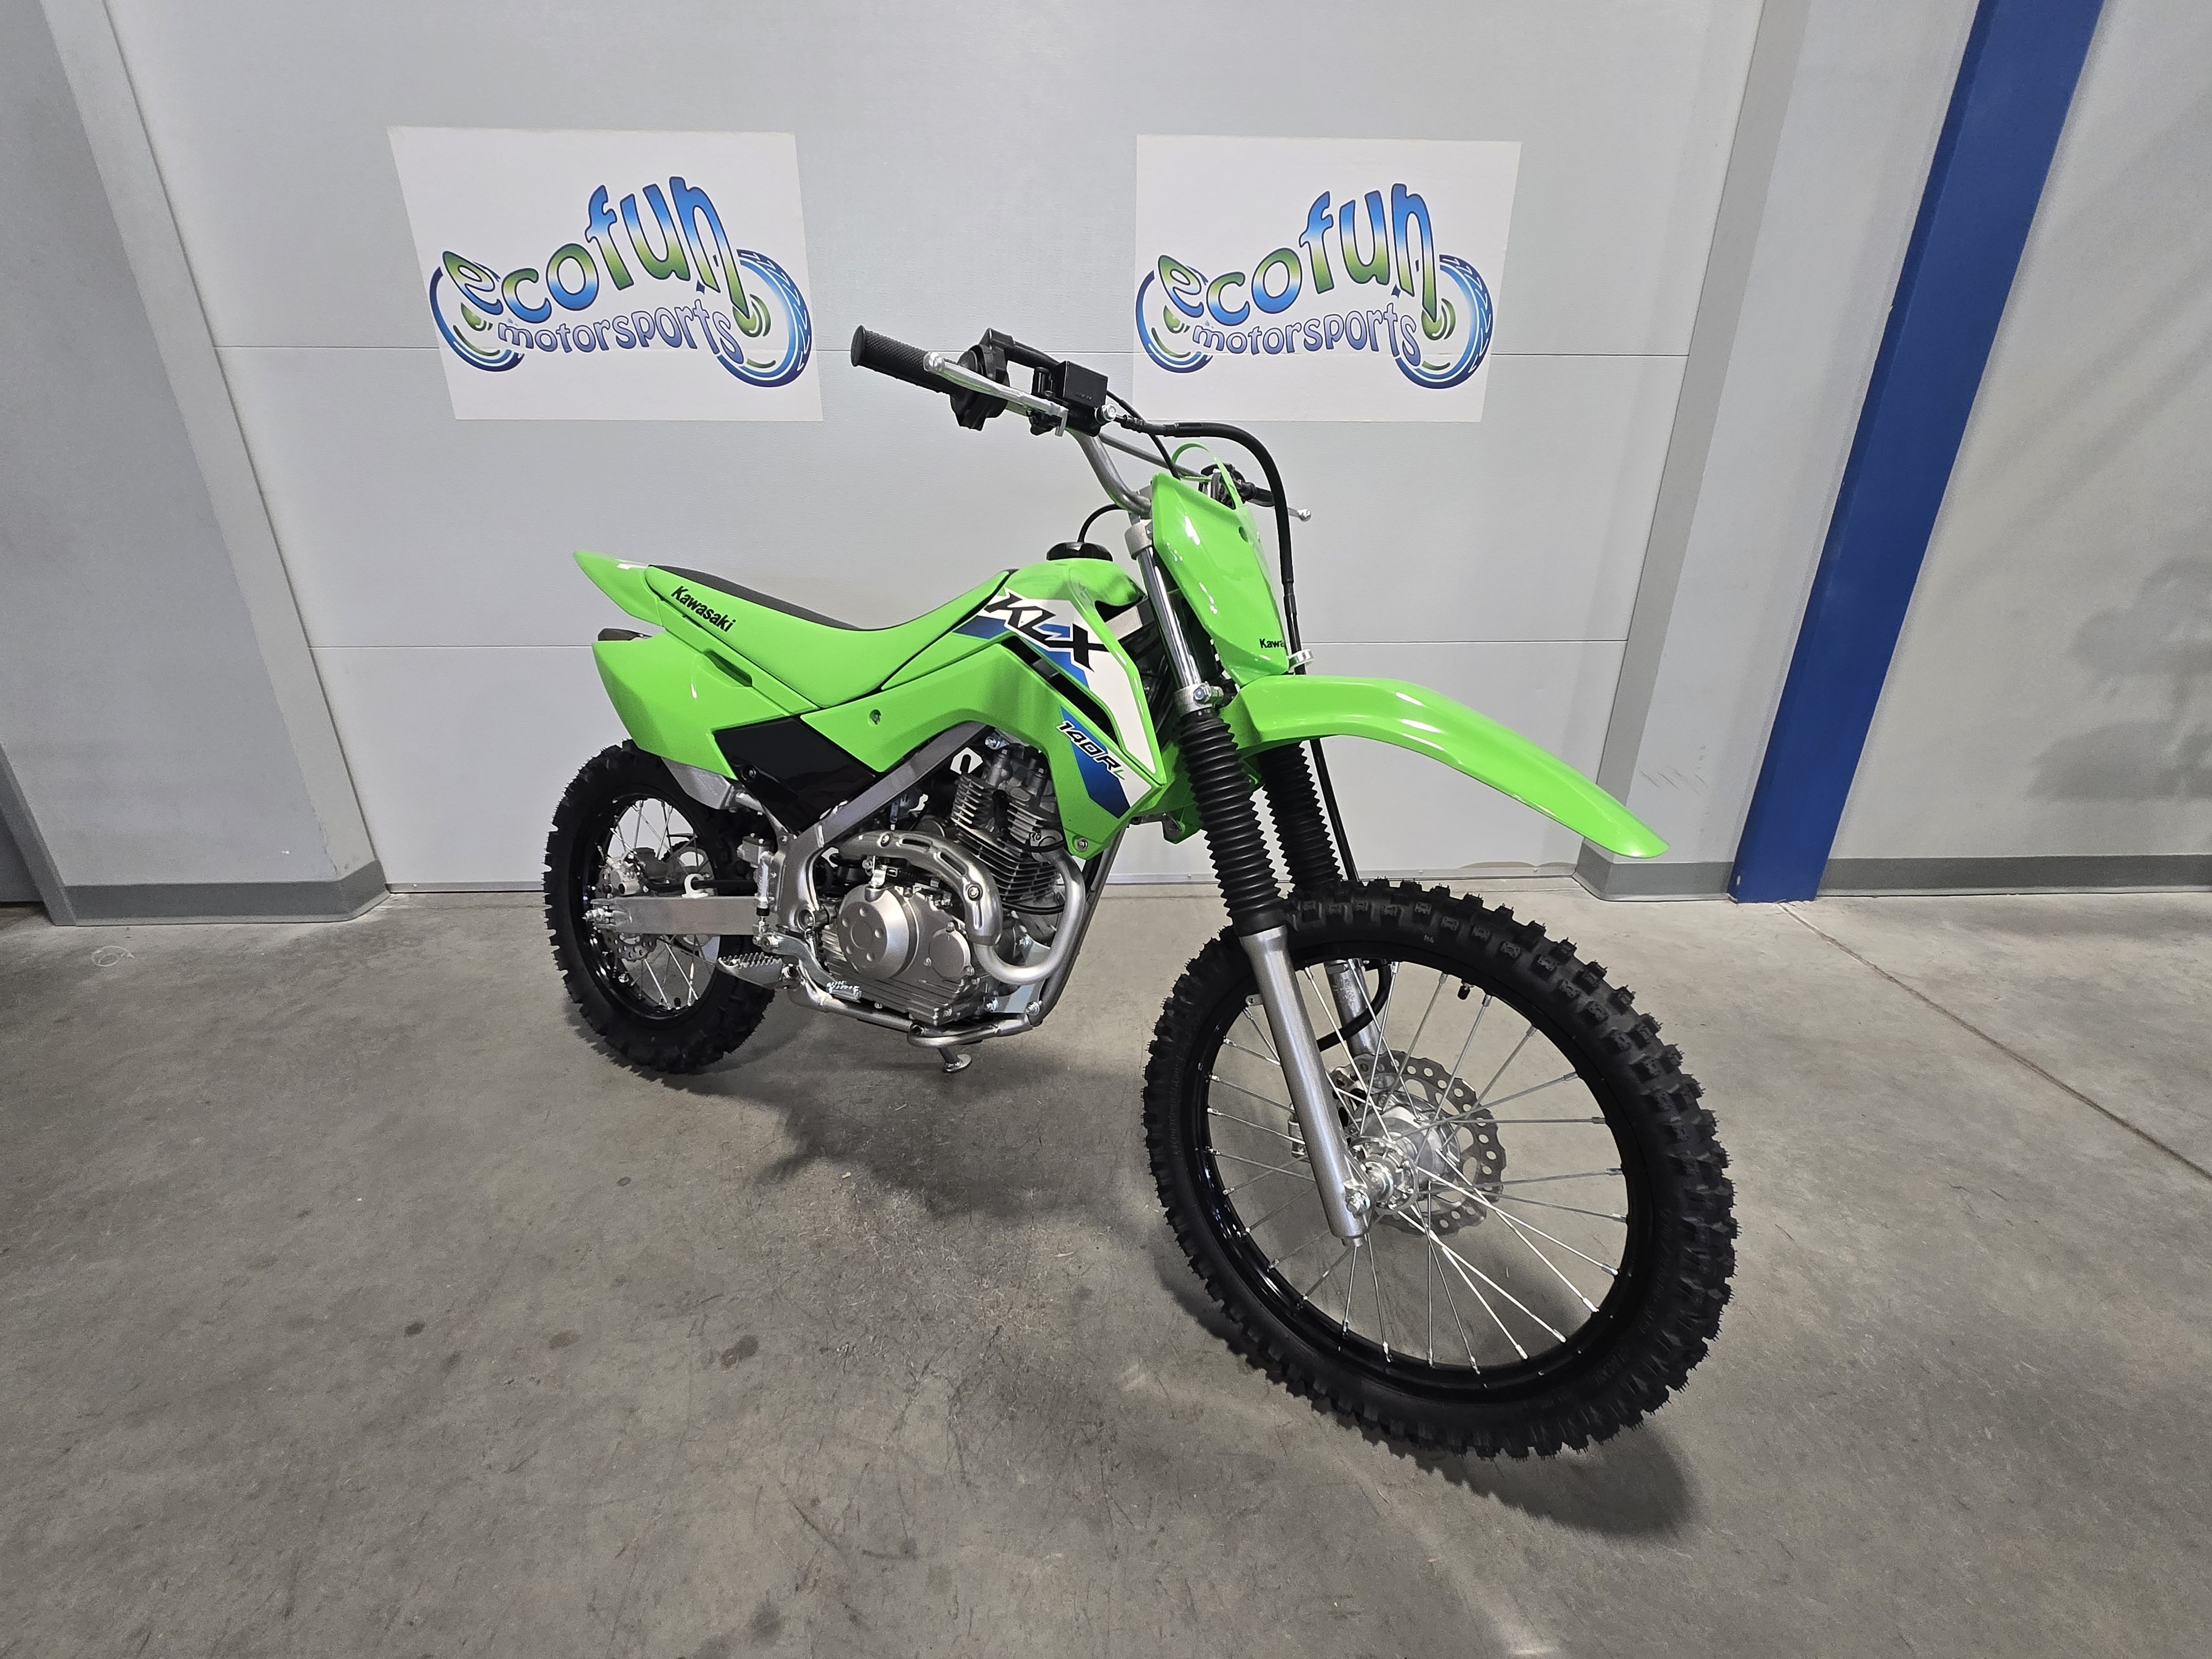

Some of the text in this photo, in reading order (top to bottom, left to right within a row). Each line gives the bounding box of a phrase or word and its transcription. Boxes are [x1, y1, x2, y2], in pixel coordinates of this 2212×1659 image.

[498, 299, 744, 365] motorsports
[1192, 302, 1422, 367] motorsports
[671, 586, 736, 632] Kawasaki
[984, 592, 1110, 672] KLX
